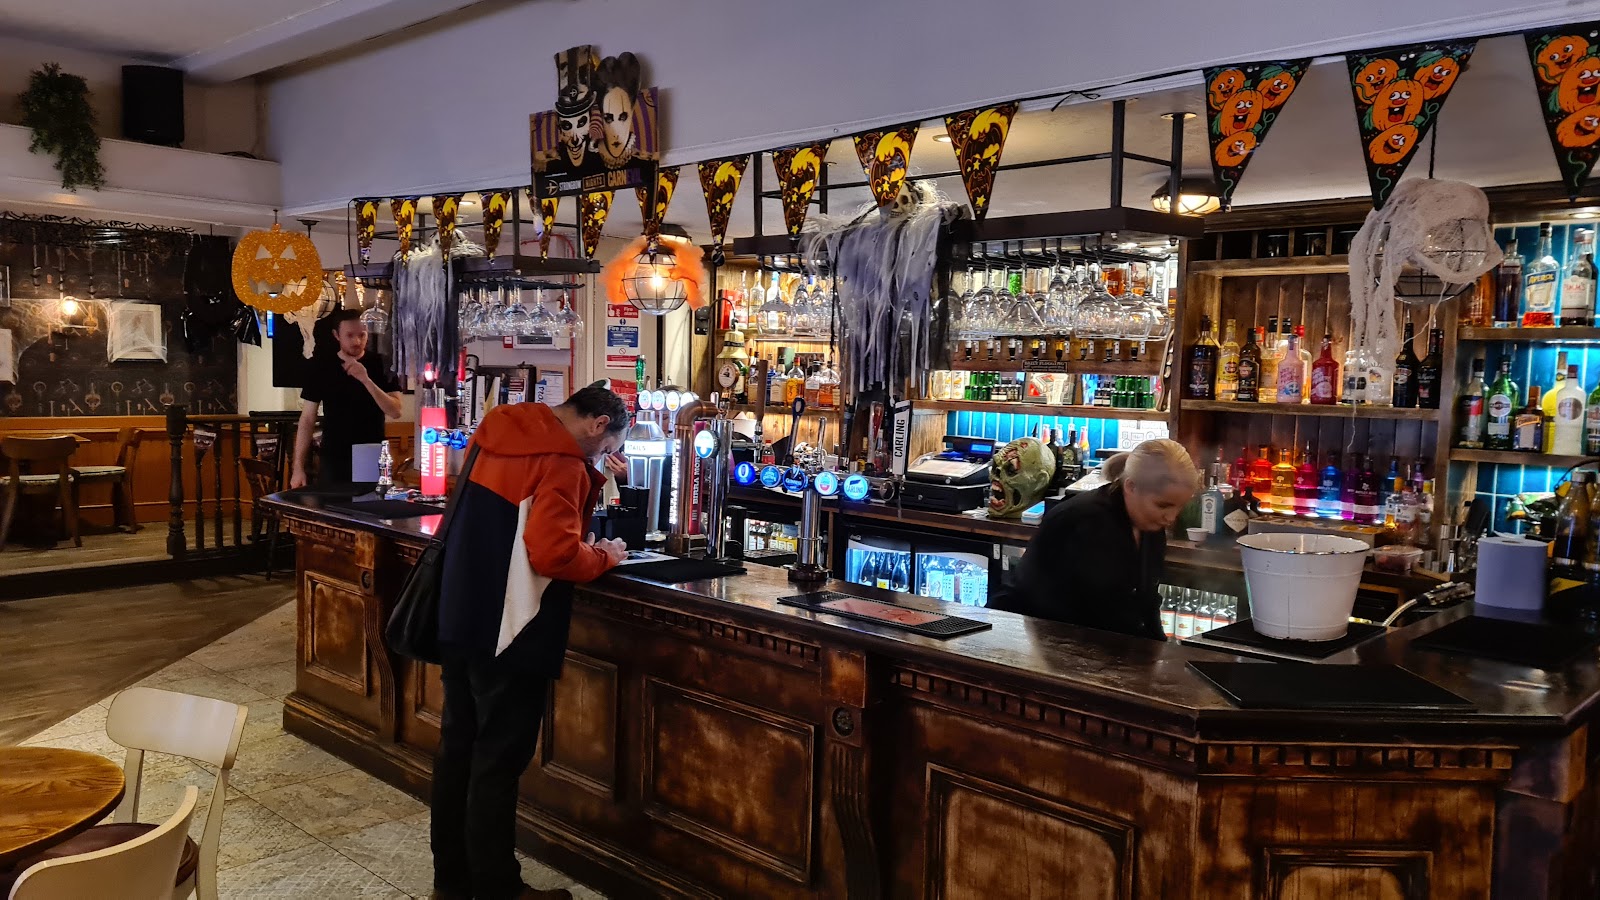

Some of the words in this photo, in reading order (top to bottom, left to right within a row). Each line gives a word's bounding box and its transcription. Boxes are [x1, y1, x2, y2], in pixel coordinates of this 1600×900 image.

[894, 419, 905, 458] CARLING
[692, 477, 700, 505] BIRRA
[785, 478, 803, 486] GUINNESS
[846, 485, 864, 494] CARLING
